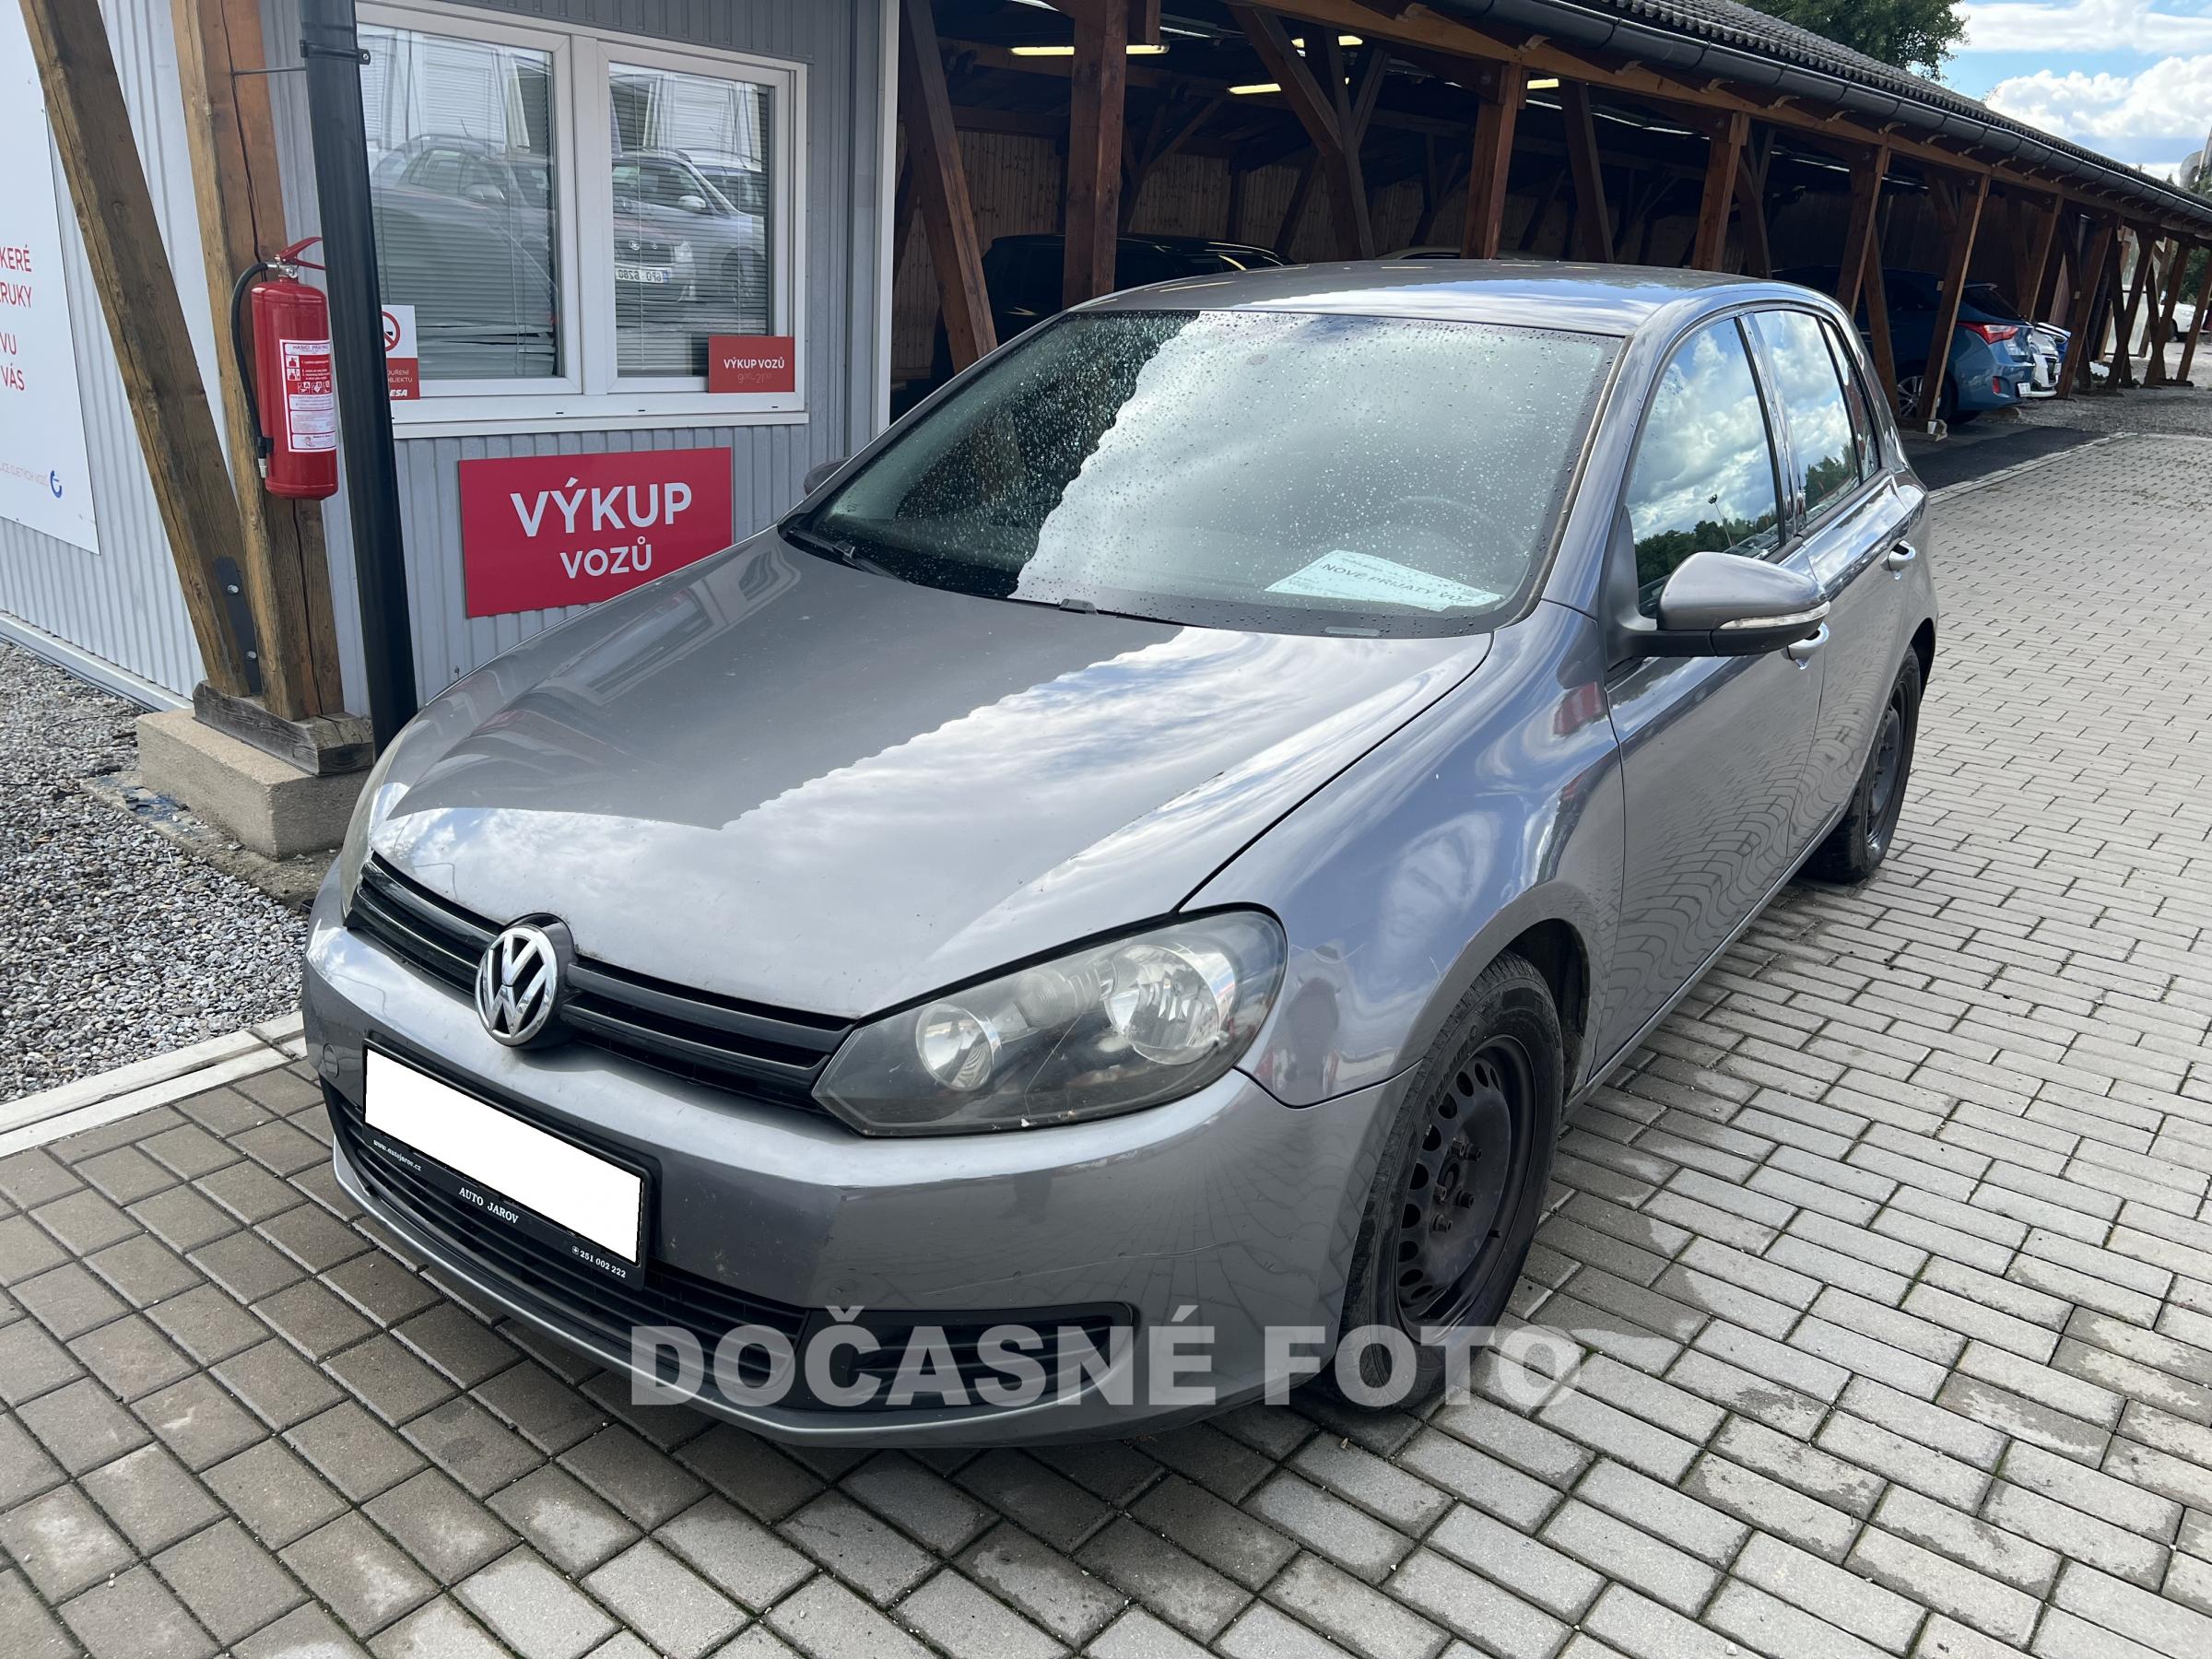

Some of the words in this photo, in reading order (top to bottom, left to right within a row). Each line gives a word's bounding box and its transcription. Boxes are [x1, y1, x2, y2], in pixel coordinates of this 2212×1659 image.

[0, 281, 32, 309] RUKY
[0, 362, 25, 391] VÁS
[724, 357, 757, 370] VÝKUP
[758, 356, 784, 370] VOZŮ
[510, 477, 692, 537] VÝKUP
[559, 535, 652, 579] VOZŮ
[459, 1186, 484, 1206] AUTO
[487, 1202, 520, 1225] JAROV
[580, 1250, 594, 1263] 251
[595, 1258, 610, 1271] 002
[611, 1265, 627, 1278] 222
